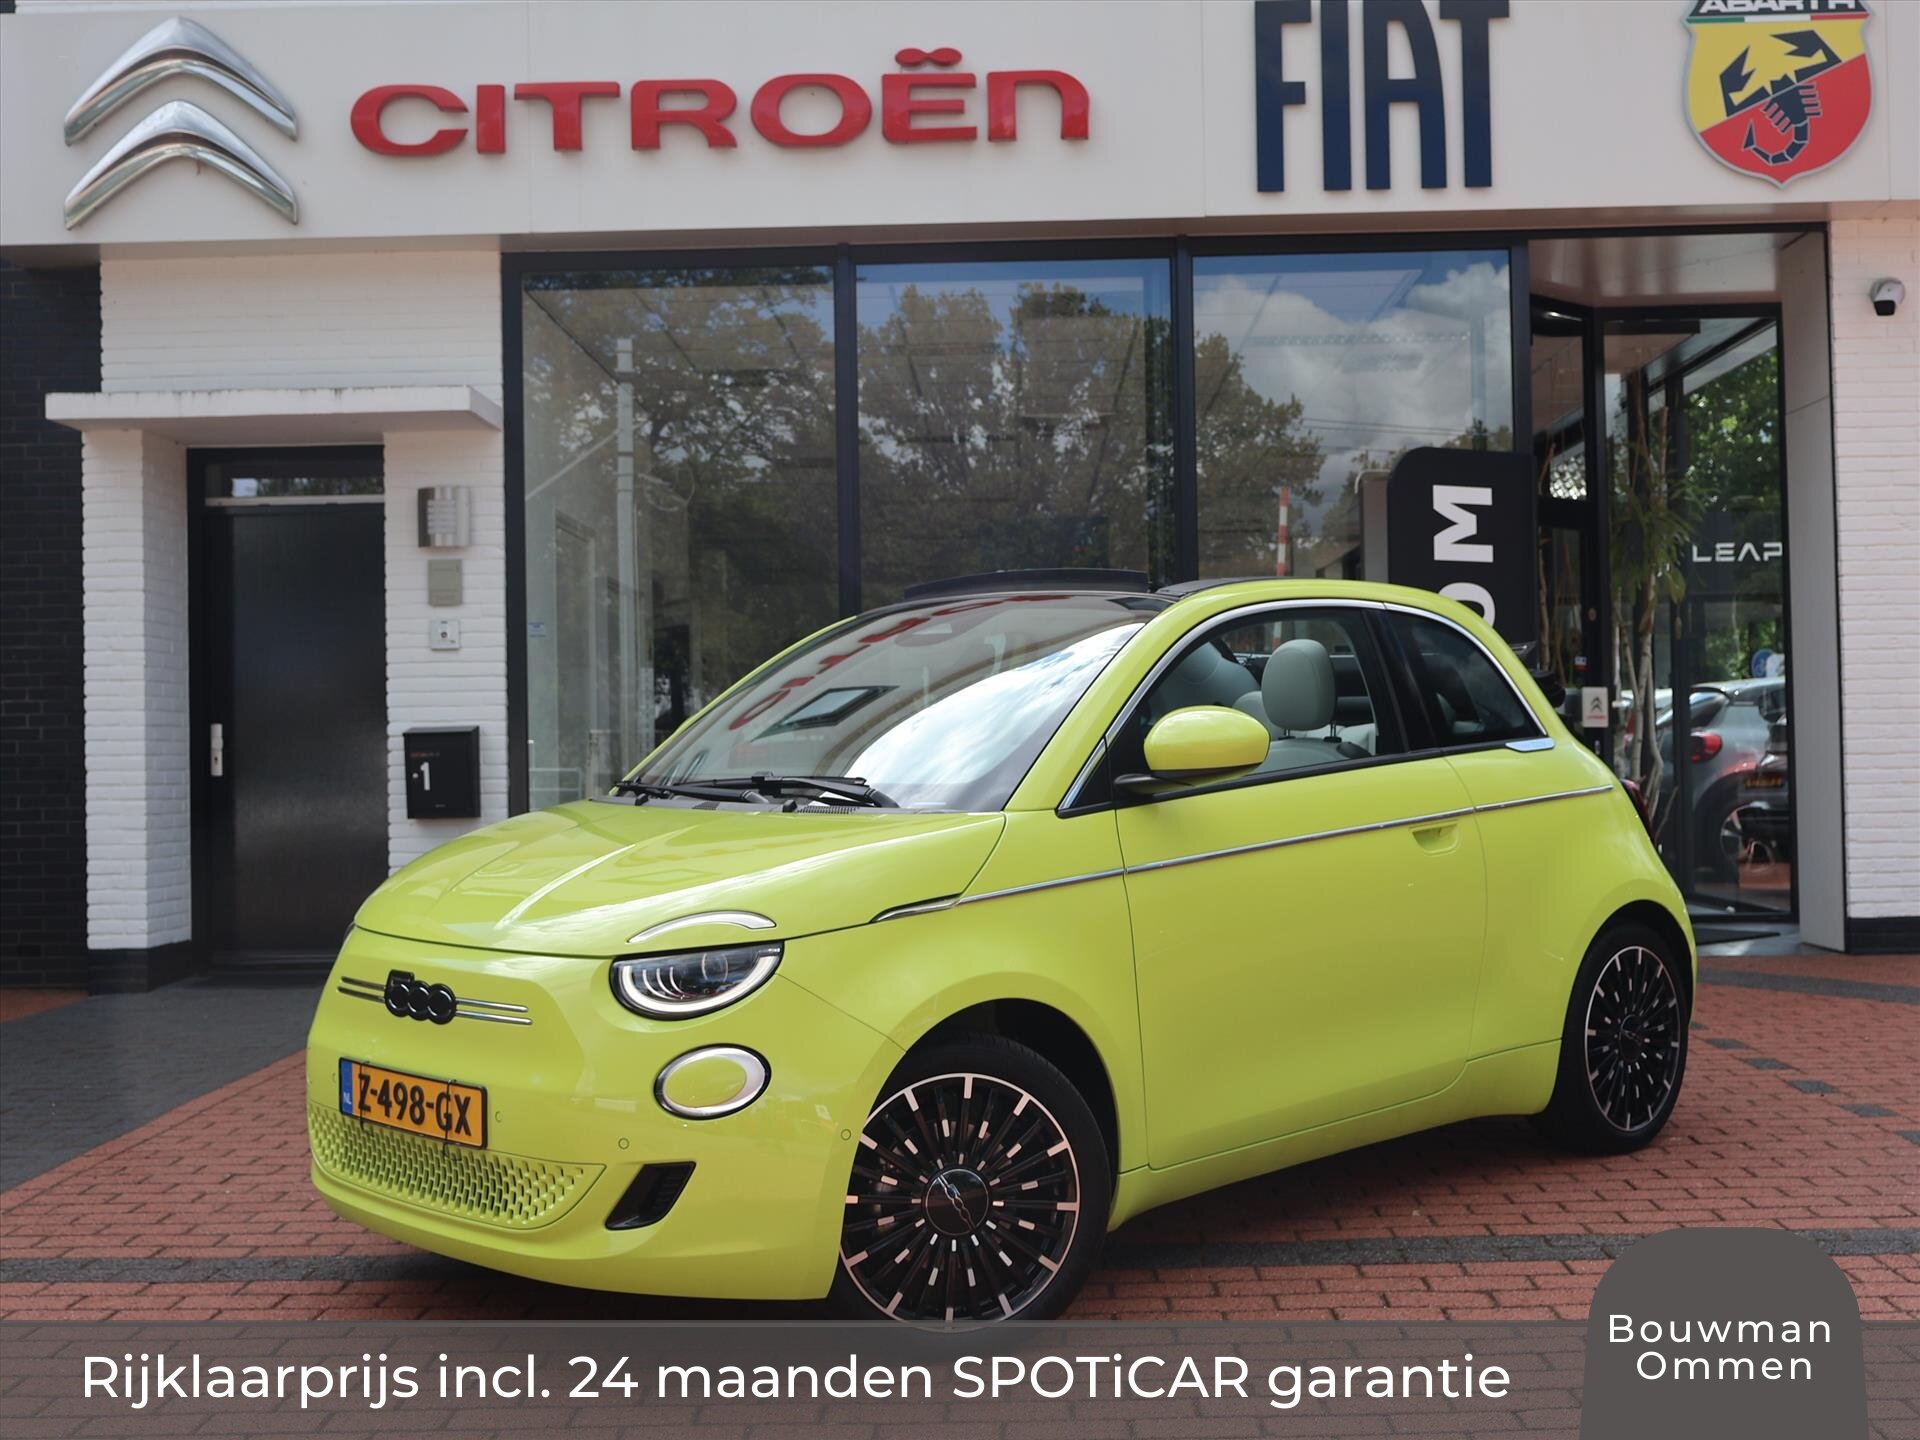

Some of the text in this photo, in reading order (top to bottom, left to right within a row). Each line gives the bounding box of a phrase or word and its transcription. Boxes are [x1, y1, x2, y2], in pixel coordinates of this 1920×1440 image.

[350, 47, 1090, 157] CITROËN
[1254, 0, 1510, 193] FIAT
[1692, 542, 1783, 562] LEAP
[420, 761, 431, 791] 1
[358, 1072, 472, 1137] Z-498-GX
